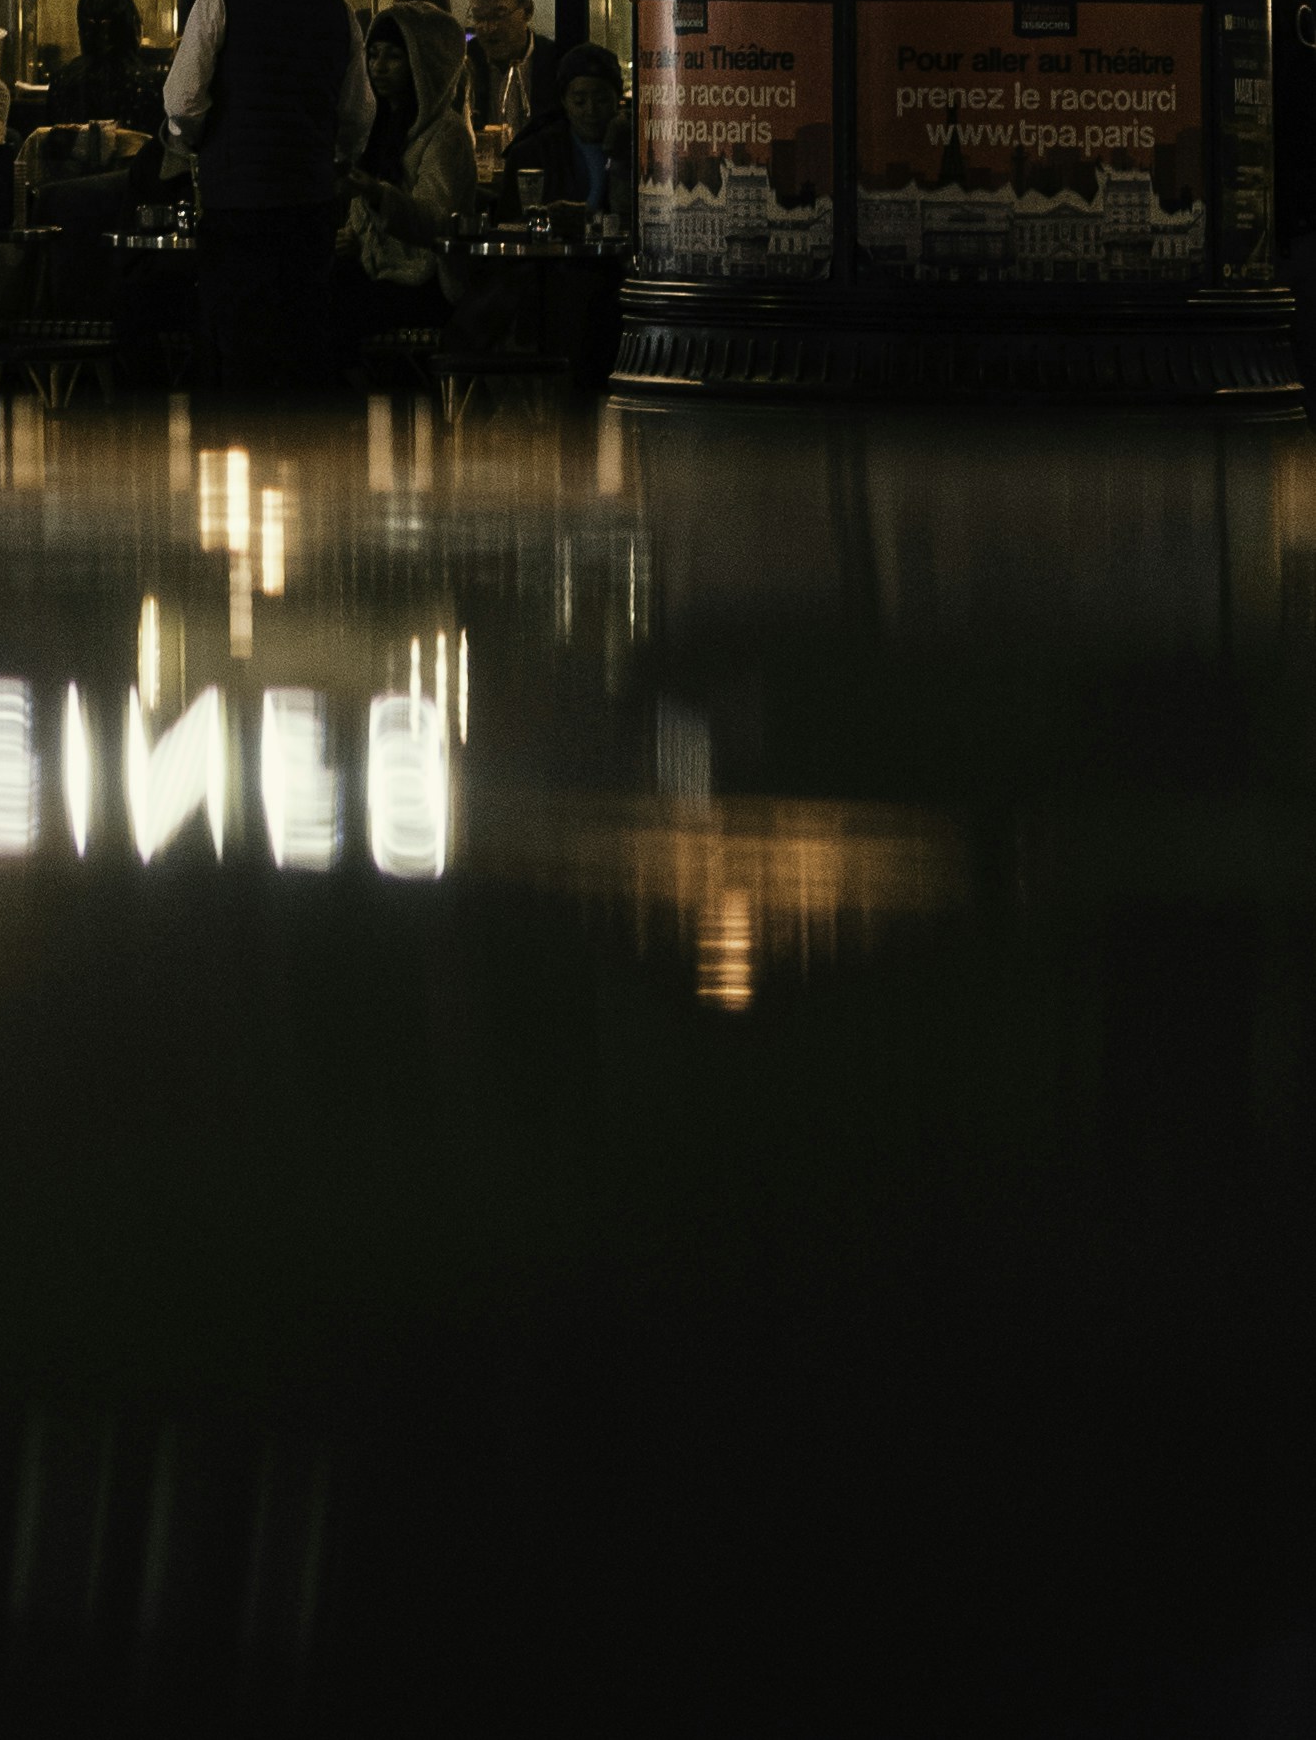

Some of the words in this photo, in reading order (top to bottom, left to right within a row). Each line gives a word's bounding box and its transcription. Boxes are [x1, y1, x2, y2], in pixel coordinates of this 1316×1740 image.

[684, 51, 704, 70] au
[708, 43, 795, 71] Théâtre
[896, 46, 964, 72] Pour
[971, 46, 1029, 72] aller
[1038, 51, 1071, 73] au
[1078, 46, 1175, 76] Théâtre
[690, 79, 797, 108] raccourci
[895, 86, 1005, 118] prenez
[1014, 82, 1041, 110] le
[1050, 83, 1178, 113] raccourci
[925, 118, 1156, 158] www.tpa.paris
